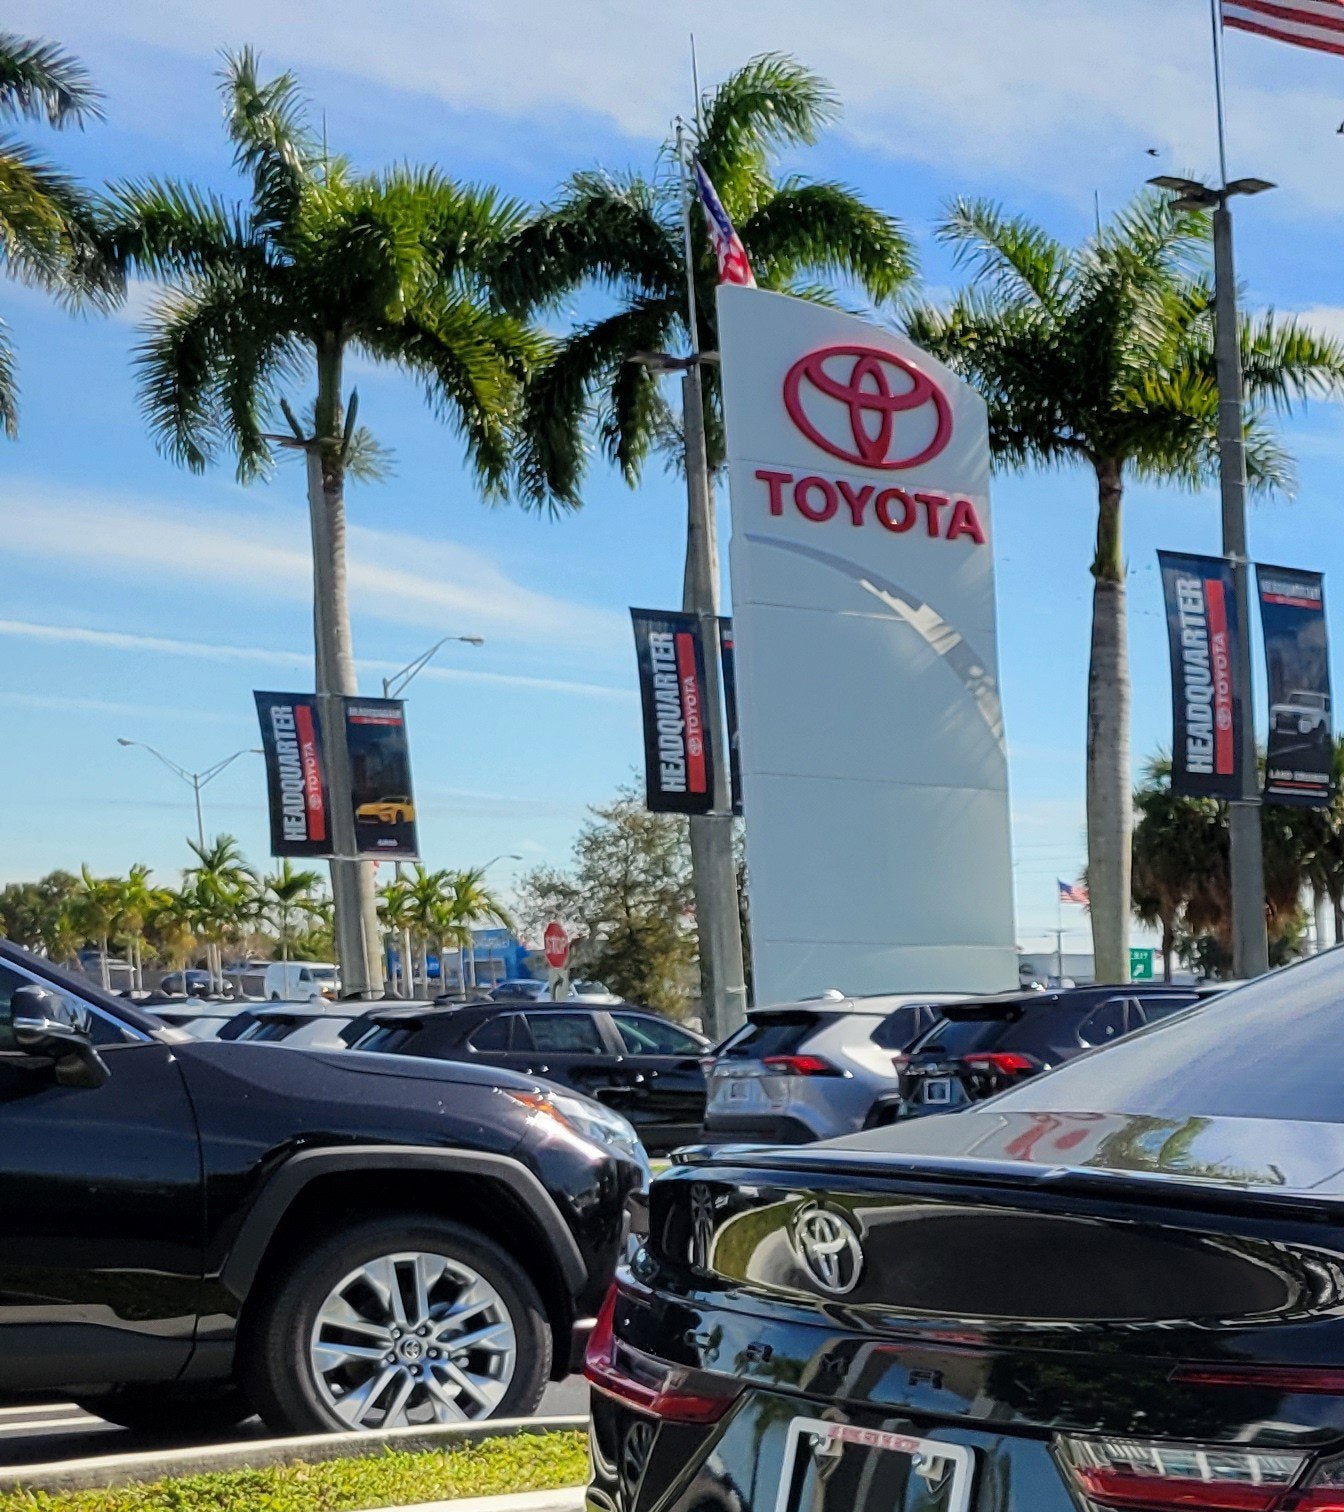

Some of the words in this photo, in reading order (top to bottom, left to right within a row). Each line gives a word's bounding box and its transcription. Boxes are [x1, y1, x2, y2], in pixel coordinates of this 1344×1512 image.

[755, 469, 986, 546] TOYOTA
[683, 676, 703, 735] TOYOTA
[1175, 576, 1214, 775] HEADQUARTER
[1210, 633, 1230, 709] TOYOTA
[648, 631, 687, 793] HEADQUARTER
[270, 705, 308, 842] HEADQUARTER
[302, 742, 320, 794] TOYOTA
